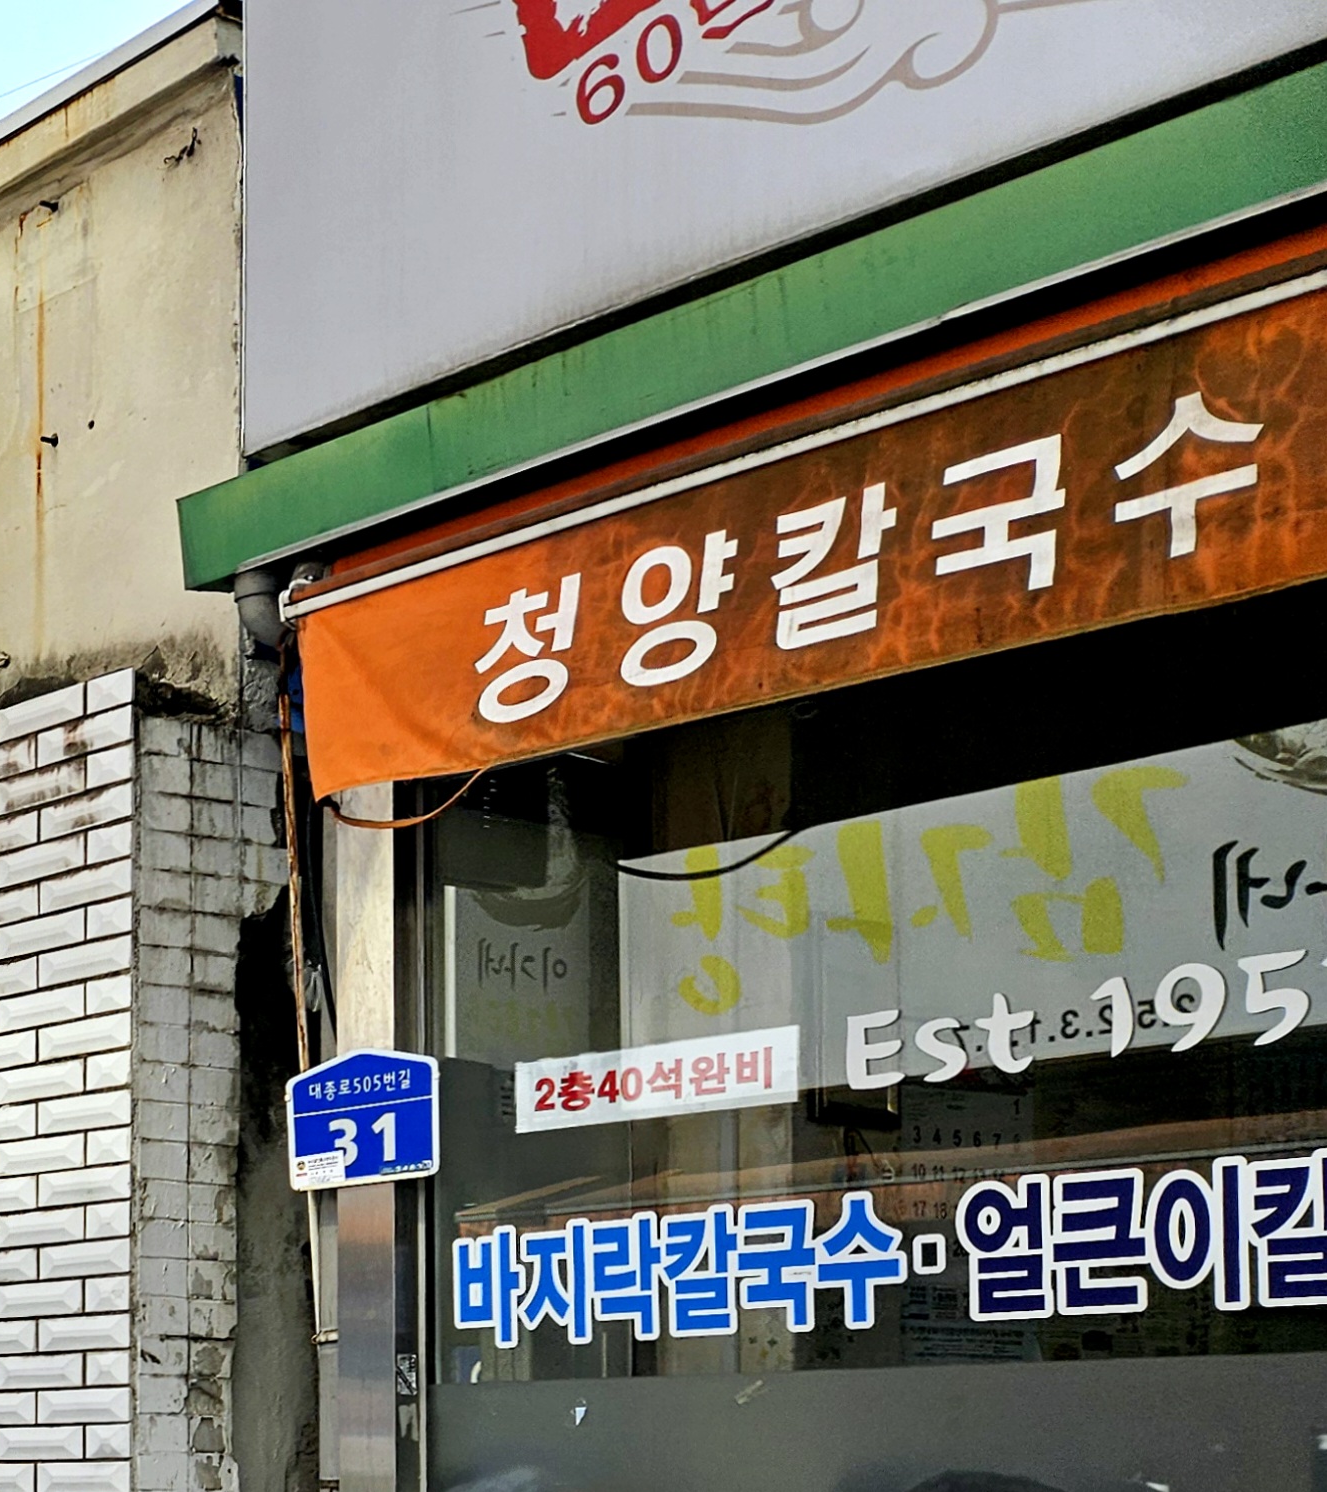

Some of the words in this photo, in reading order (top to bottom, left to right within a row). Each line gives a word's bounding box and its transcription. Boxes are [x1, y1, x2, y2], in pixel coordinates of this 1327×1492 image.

[474, 391, 1264, 724] 청양칼국수
[846, 991, 1035, 1091] Est
[1090, 949, 1310, 1058] 195
[308, 1067, 412, 1102] 대종로505번길
[328, 1111, 397, 1169] 31
[912, 1125, 922, 1144] 3
[932, 1127, 942, 1145] 4
[952, 1129, 963, 1147] 5
[973, 1131, 983, 1148] 6
